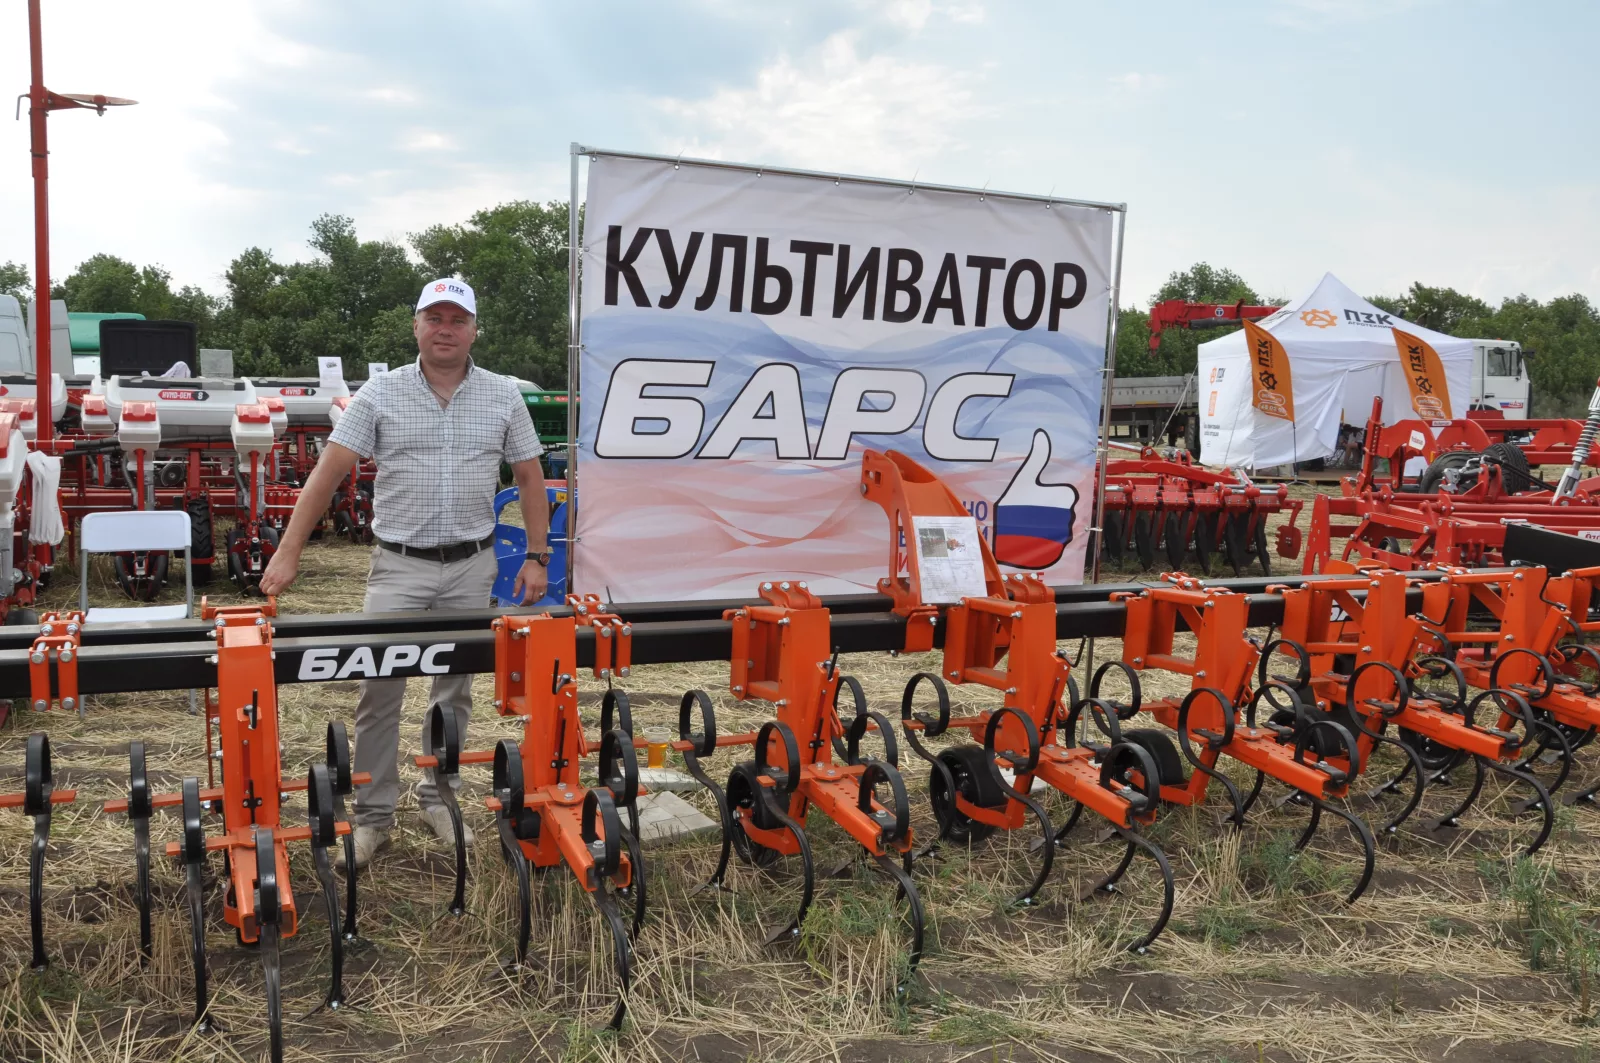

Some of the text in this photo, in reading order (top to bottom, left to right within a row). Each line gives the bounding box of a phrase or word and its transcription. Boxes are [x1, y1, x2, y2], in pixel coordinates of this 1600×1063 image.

[604, 224, 1088, 332] КУЛЬТИВАТОР
[1343, 308, 1394, 326] ПЗК
[1257, 338, 1270, 368] ПЗК
[1408, 345, 1422, 373] ПЗК
[594, 357, 1016, 462] БАРС
[297, 643, 456, 681] БАРС
